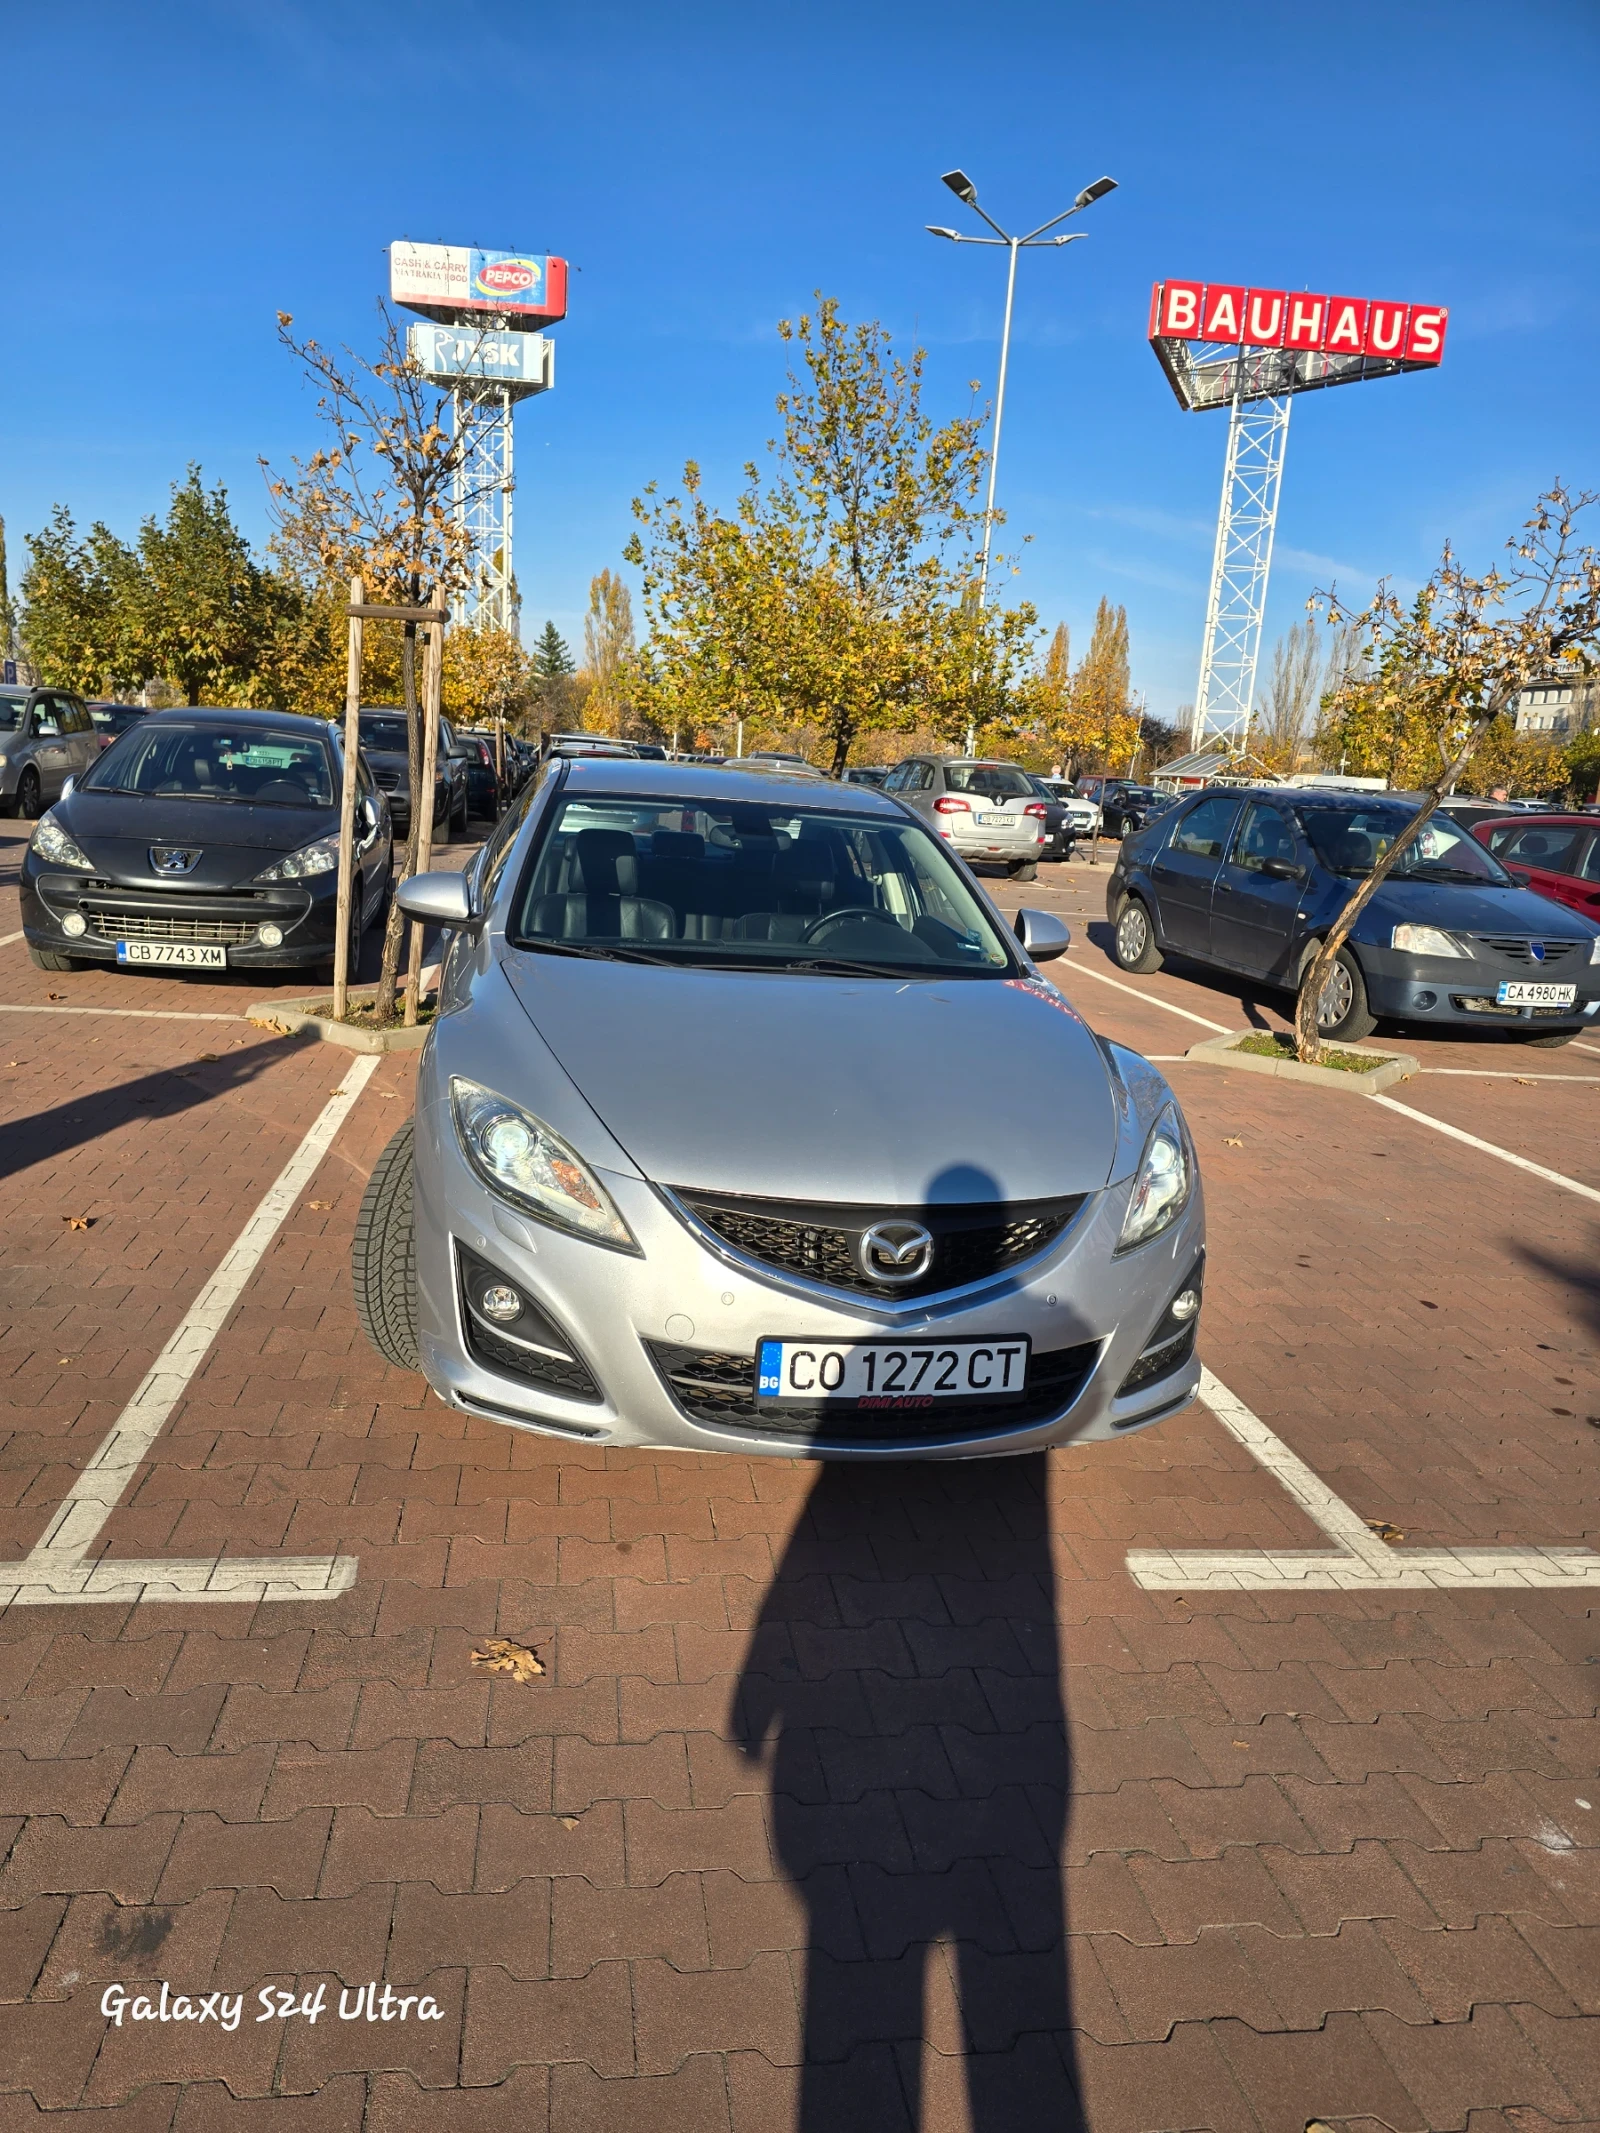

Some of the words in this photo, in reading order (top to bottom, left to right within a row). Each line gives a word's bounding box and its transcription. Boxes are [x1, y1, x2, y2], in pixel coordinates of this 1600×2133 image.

[394, 257, 421, 268] CASH
[434, 261, 467, 273] CARRY
[486, 269, 531, 286] PEPCO
[452, 340, 520, 367] JYSK
[129, 945, 151, 960] CB
[154, 946, 196, 963] 7743
[200, 948, 222, 964] XM
[1507, 985, 1524, 1000] CA
[1527, 985, 1557, 1001] 4980
[1558, 986, 1573, 1001] HK
[760, 1375, 779, 1389] BG
[790, 1350, 845, 1391] CO
[862, 1350, 958, 1392] 1272
[967, 1347, 1021, 1389] CT
[857, 1396, 892, 1409] DIMI
[892, 1396, 934, 1409] AUTO
